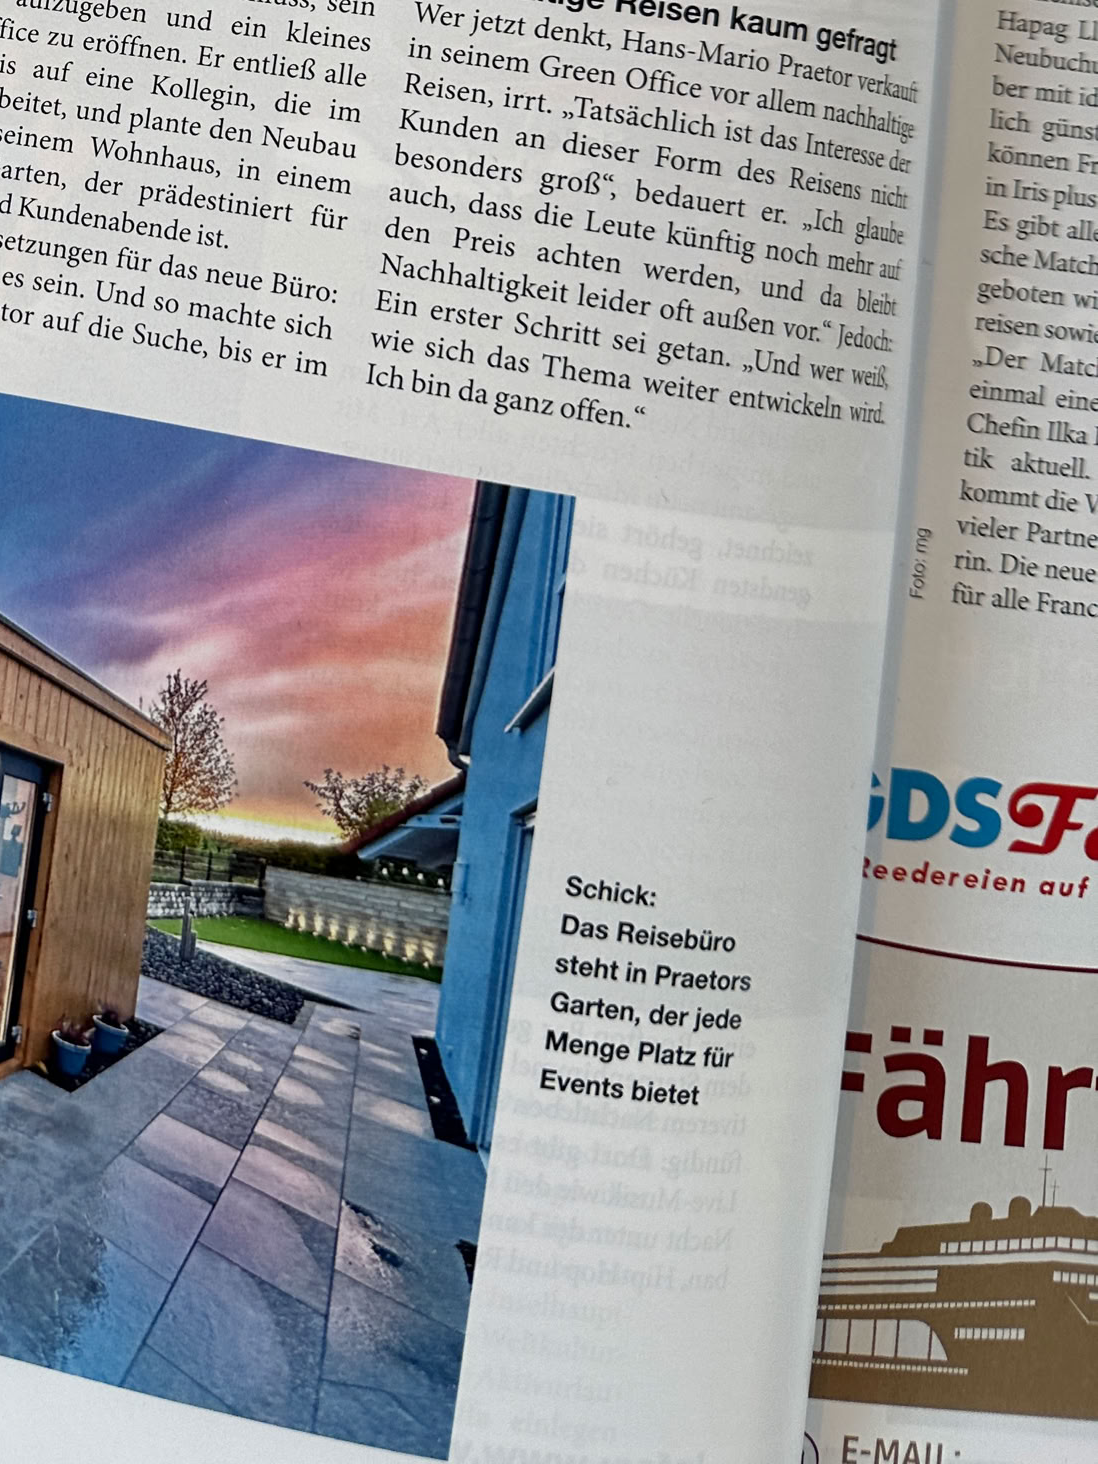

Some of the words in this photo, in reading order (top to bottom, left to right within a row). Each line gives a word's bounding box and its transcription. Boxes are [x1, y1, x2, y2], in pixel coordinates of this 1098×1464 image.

[730, 6, 808, 42] kaum
[816, 28, 898, 64] gefragt
[997, 10, 1069, 44] Hapag
[987, 141, 1070, 171] können
[985, 176, 1008, 198] in
[1013, 179, 1049, 202] Iris
[983, 210, 1010, 231] Es
[1016, 215, 1060, 240] gibt
[116, 247, 152, 272] für
[159, 254, 197, 280] das
[271, 272, 337, 304] Büro:
[977, 279, 1065, 306] geboten
[975, 317, 1040, 337] reisen
[366, 363, 404, 390] Ich
[412, 369, 450, 398] bin
[458, 379, 488, 405] da
[493, 392, 554, 416] ganz
[969, 380, 1045, 406] einmal
[967, 413, 1040, 440] Chefin
[1047, 421, 1088, 445] Ilka
[964, 447, 993, 469] tik
[1011, 452, 1091, 480] aktuell.
[959, 479, 1040, 508] kommt
[1045, 489, 1079, 512] die
[957, 516, 1019, 540] vieler
[954, 550, 992, 572] rin.
[1000, 553, 1039, 577] Die
[952, 582, 985, 606] für
[991, 587, 1030, 611] alle
[565, 875, 656, 907] Schick:
[1039, 876, 1090, 898] auf
[560, 914, 608, 940] Das
[617, 922, 736, 953] Reisebüro
[555, 956, 619, 981] steht
[625, 962, 647, 984] in
[655, 965, 751, 992] Praetors
[550, 991, 640, 1026] Garten,
[649, 1004, 689, 1026] der
[693, 1007, 742, 1032] jede
[545, 1030, 630, 1063] Menge
[638, 1041, 696, 1066] Platz
[703, 1047, 734, 1068] für
[540, 1068, 624, 1099] Events
[631, 1080, 700, 1106] bietet
